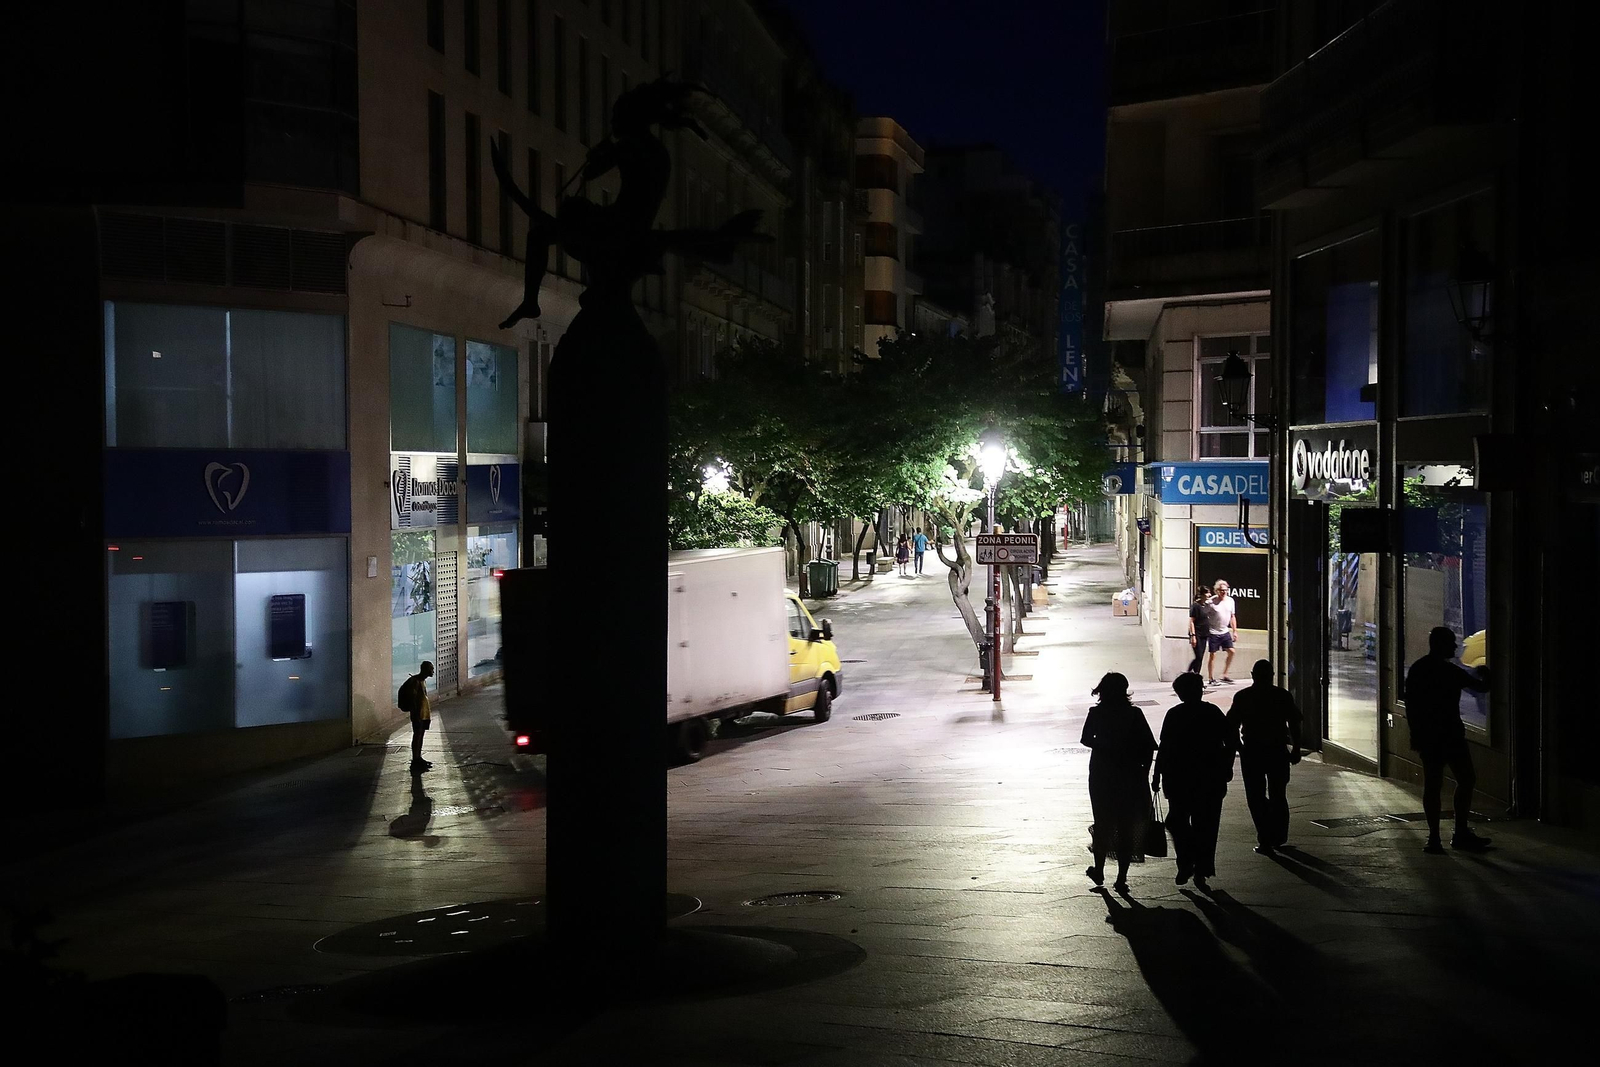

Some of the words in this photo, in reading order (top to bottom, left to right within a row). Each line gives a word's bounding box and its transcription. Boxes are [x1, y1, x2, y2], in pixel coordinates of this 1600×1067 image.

[1064, 224, 1079, 290] CASA
[1306, 439, 1369, 479] vodafone
[1177, 475, 1268, 495] CASADEL
[1205, 532, 1268, 545] OBJETOS
